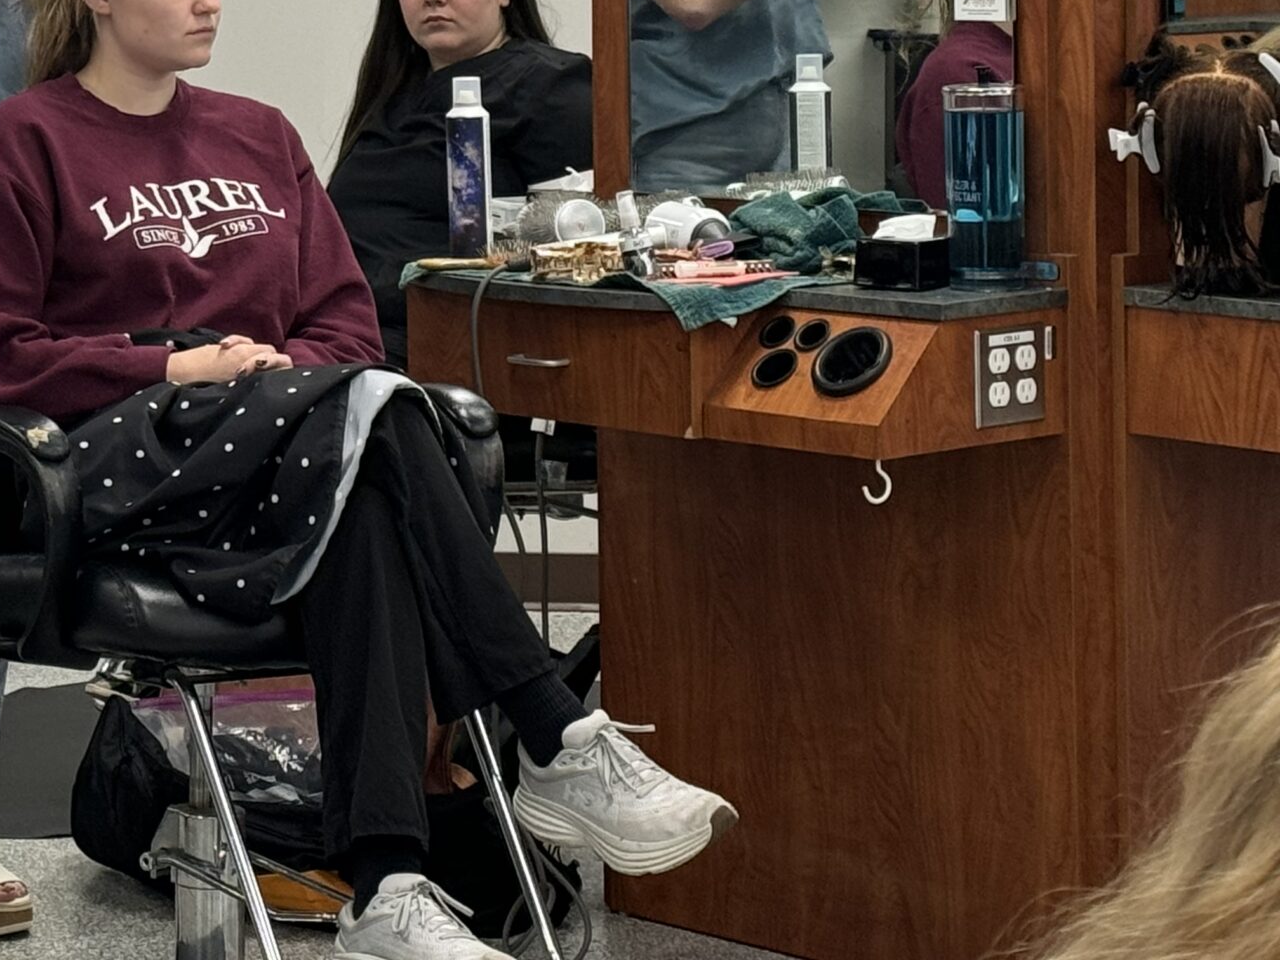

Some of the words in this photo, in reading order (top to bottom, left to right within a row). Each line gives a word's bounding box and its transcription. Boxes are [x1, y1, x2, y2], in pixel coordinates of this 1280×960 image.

[90, 178, 286, 241] LAUREL
[141, 229, 180, 244] SINCE
[222, 220, 256, 236] 1985
